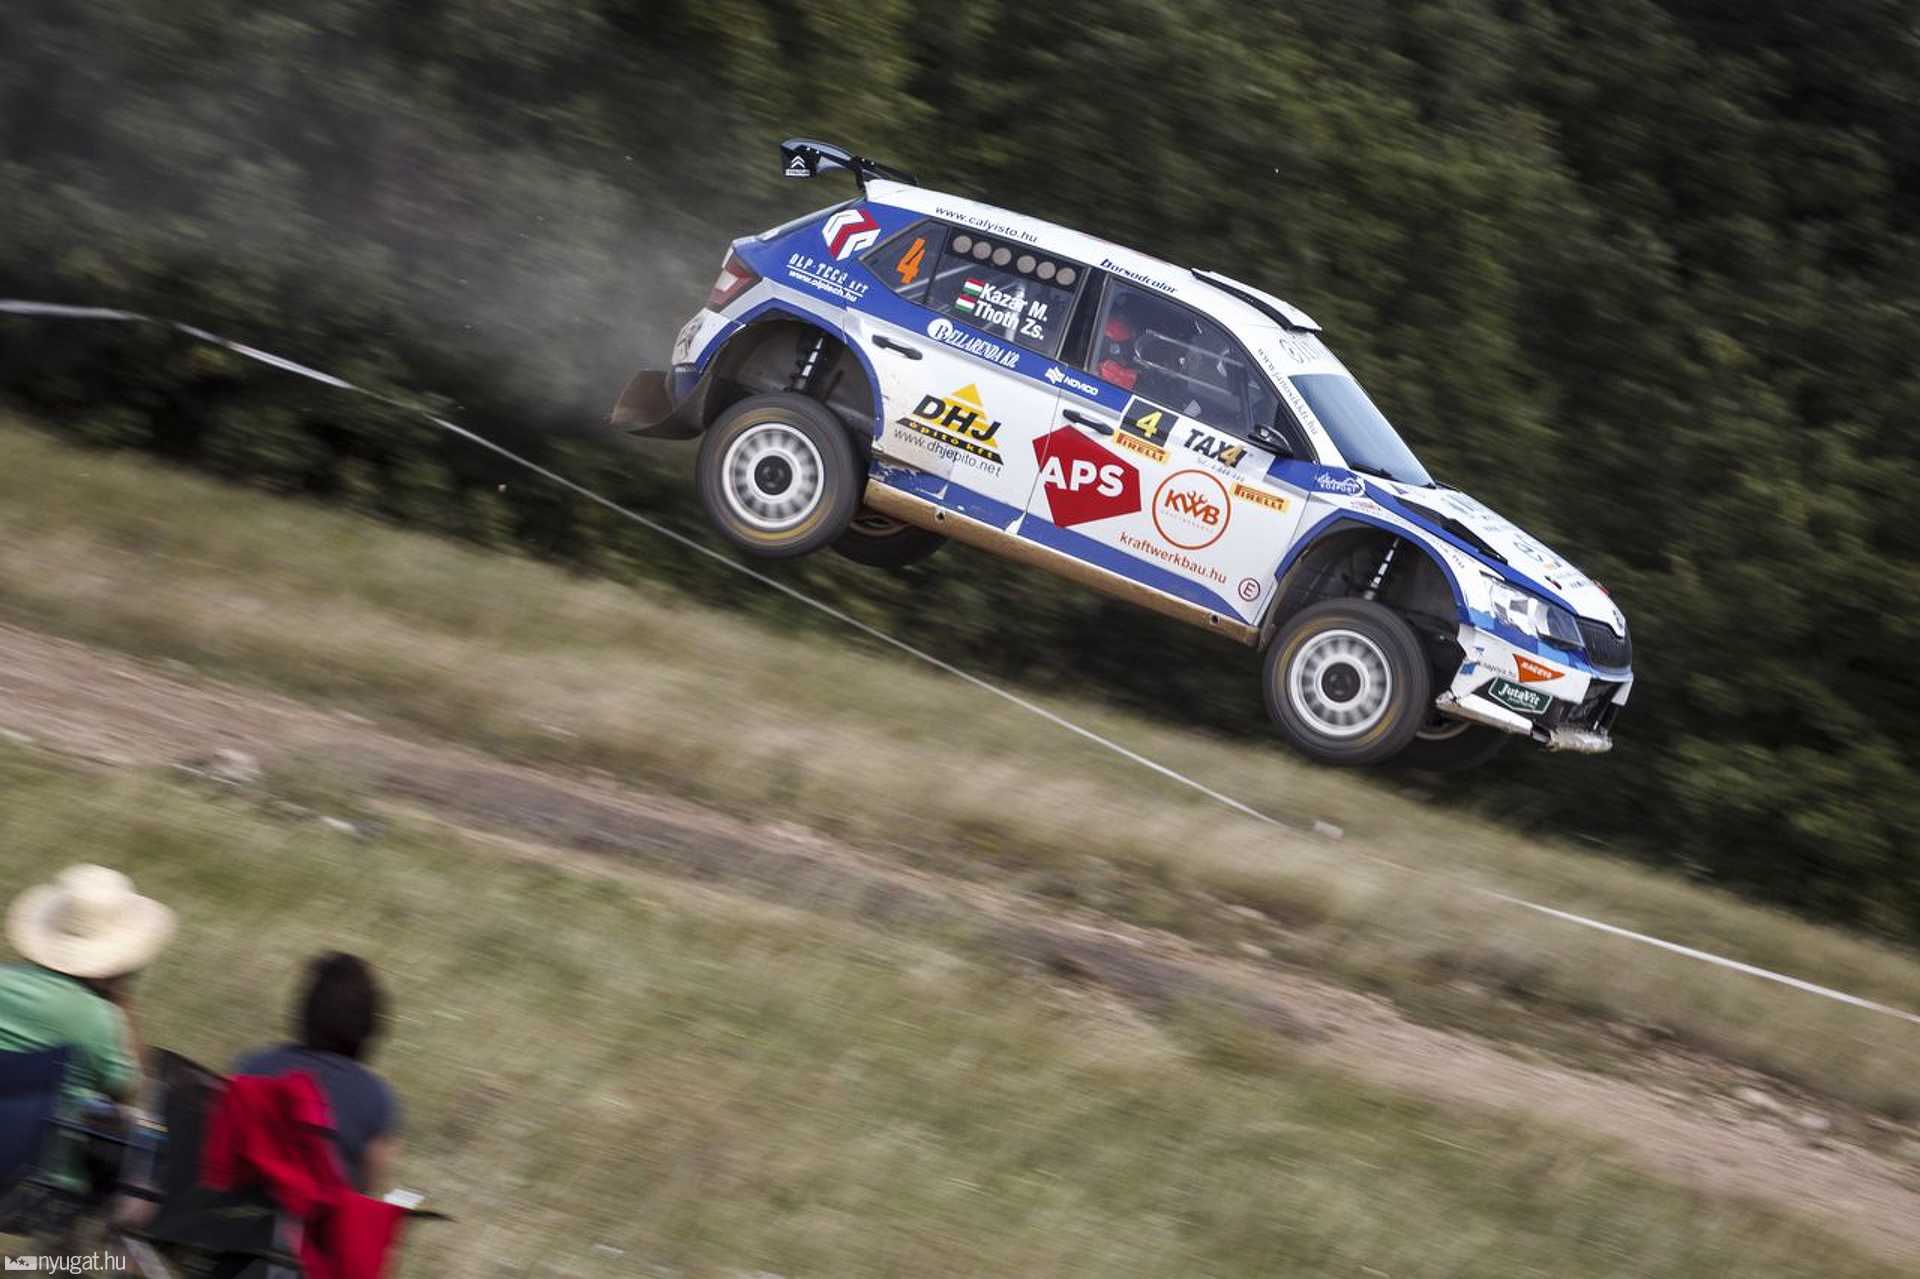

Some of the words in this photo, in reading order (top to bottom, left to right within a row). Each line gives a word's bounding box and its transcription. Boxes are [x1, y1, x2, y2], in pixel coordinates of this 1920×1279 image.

[897, 238, 926, 284] 4
[975, 300, 1019, 331] Thoth
[1021, 318, 1045, 341] Zs.
[1028, 301, 1048, 322] M.
[912, 394, 1001, 441] DHJ
[1136, 410, 1163, 438] 4
[1041, 456, 1124, 497] APS
[1164, 489, 1220, 525] KWB
[1120, 532, 1227, 584] kraftwerkbau.hu
